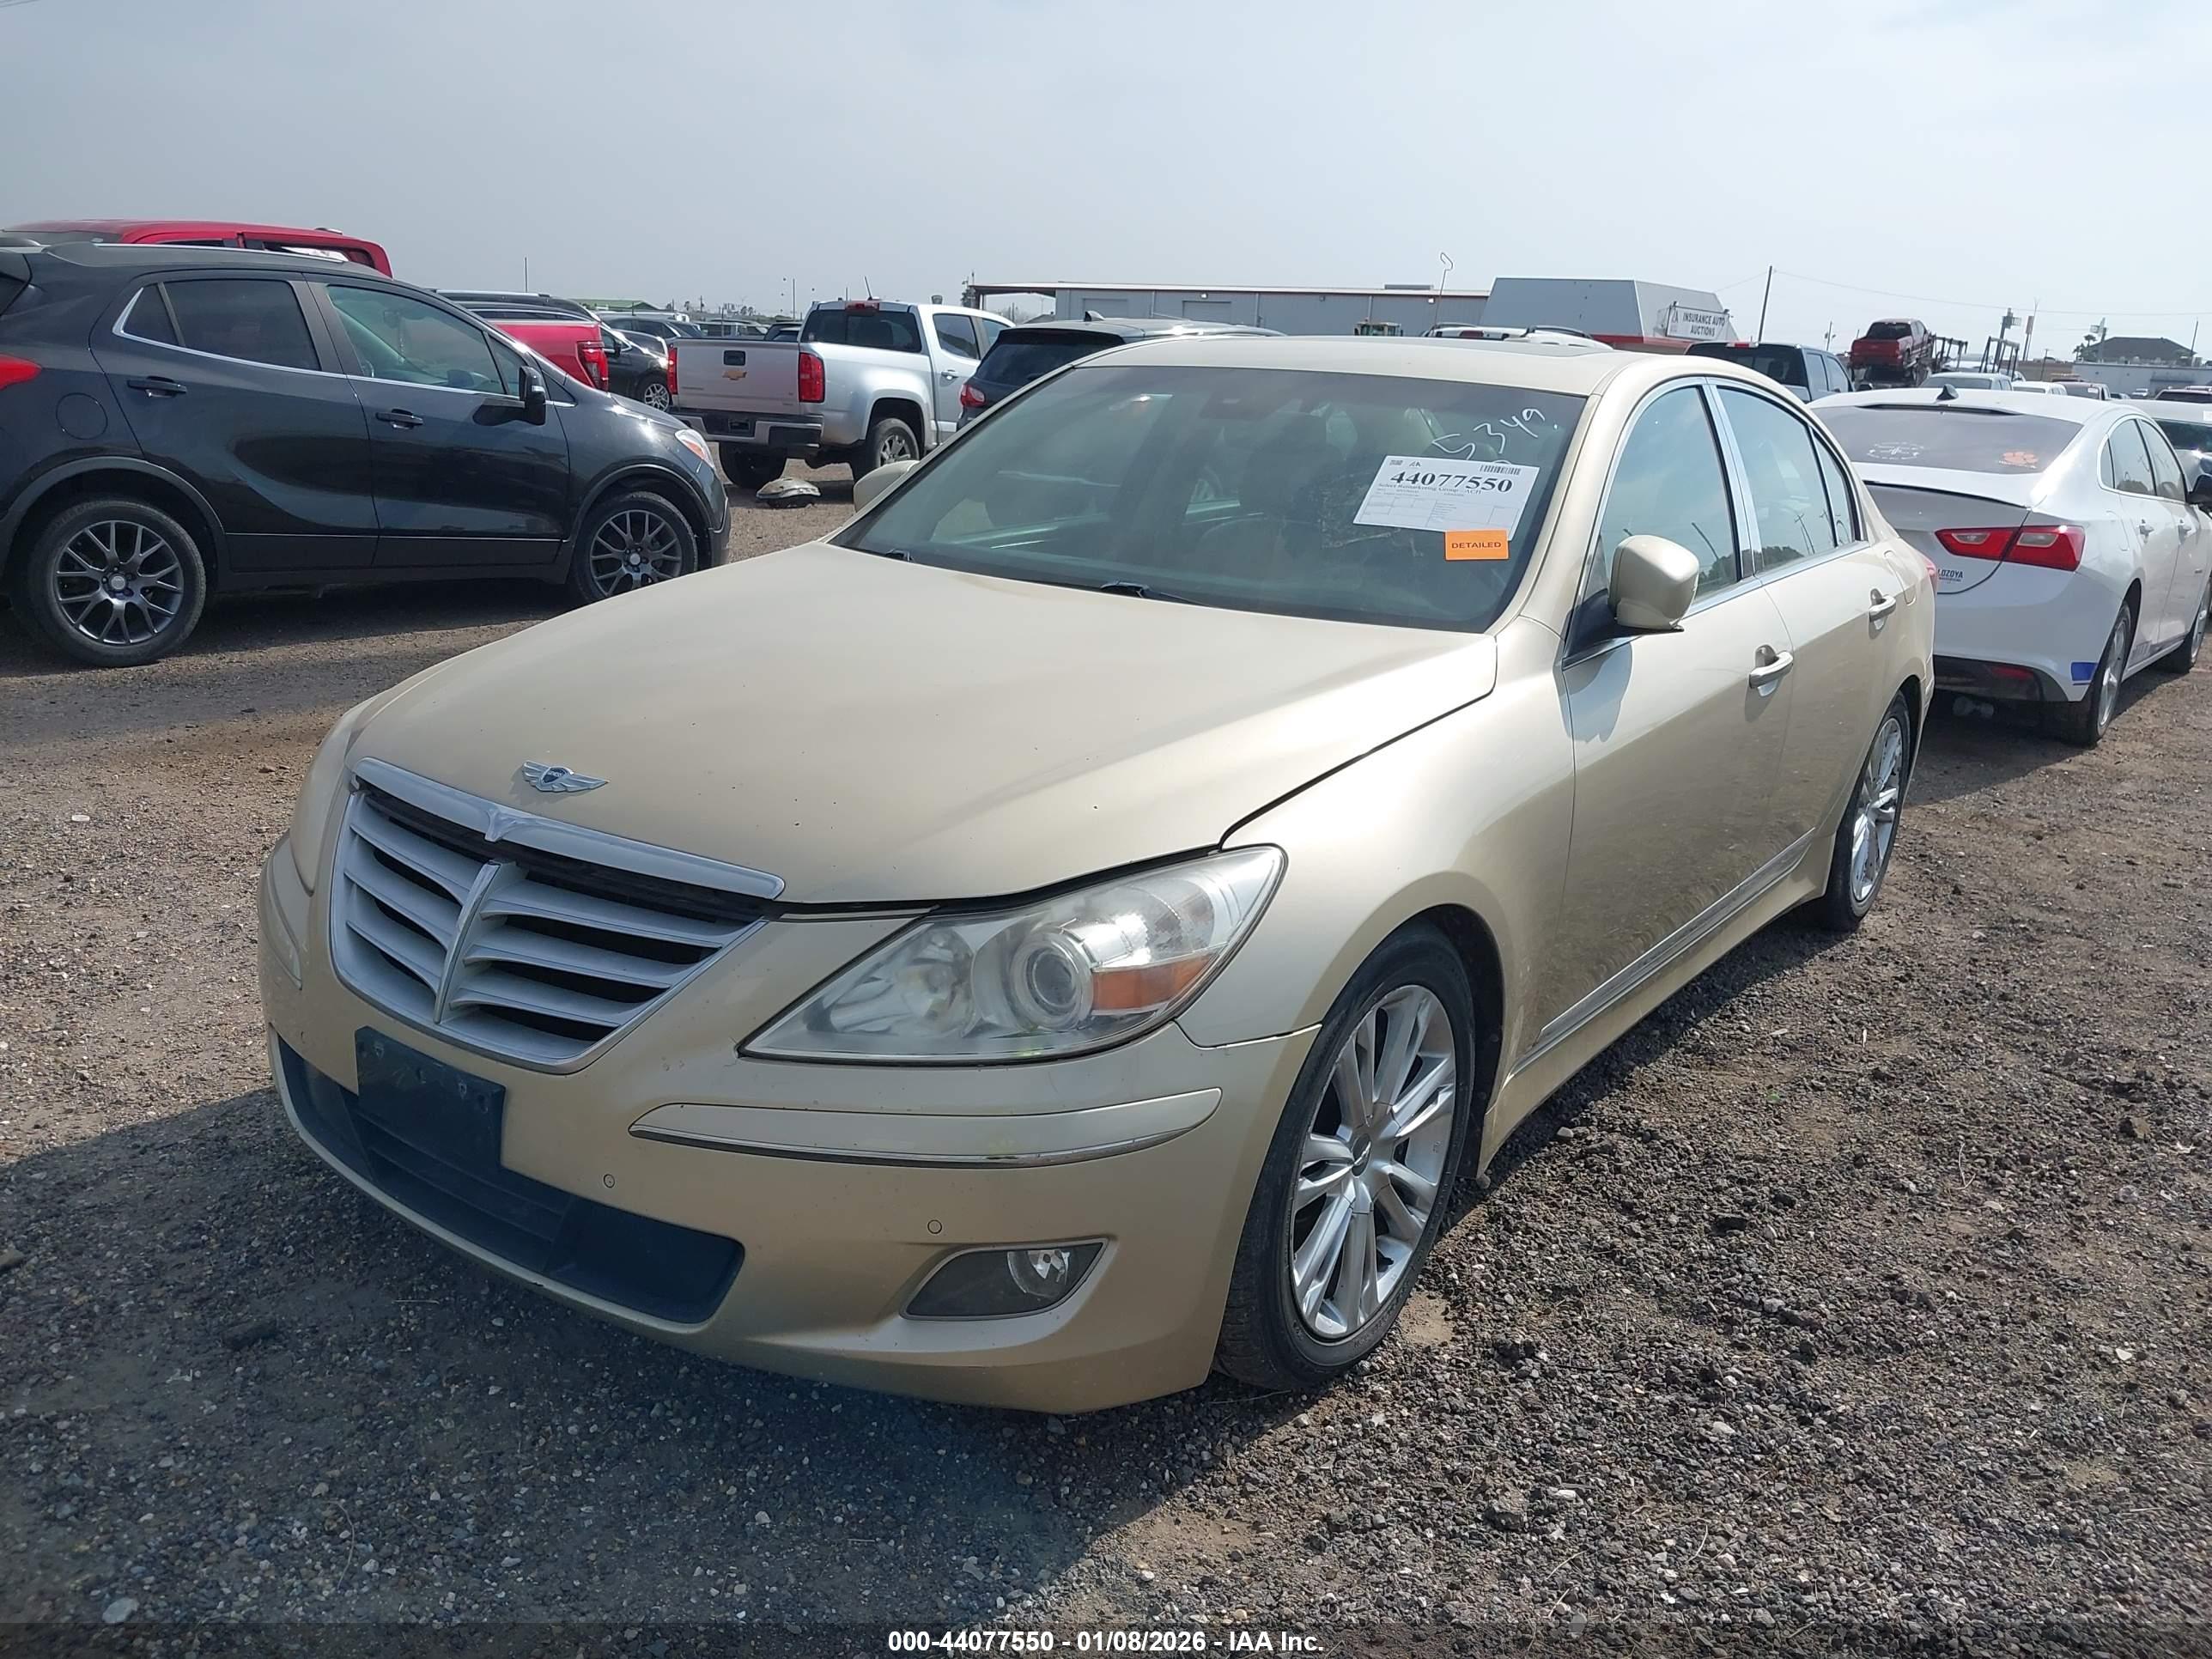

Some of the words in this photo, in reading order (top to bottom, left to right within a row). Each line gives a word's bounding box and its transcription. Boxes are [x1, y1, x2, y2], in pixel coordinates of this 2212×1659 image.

[1683, 312, 1711, 325] INSURANCE
[1712, 315, 1725, 327] AUTO
[1690, 325, 1716, 337] AUCTIONS
[1390, 471, 1513, 493] 44077550
[1451, 541, 1502, 550] DETAILED
